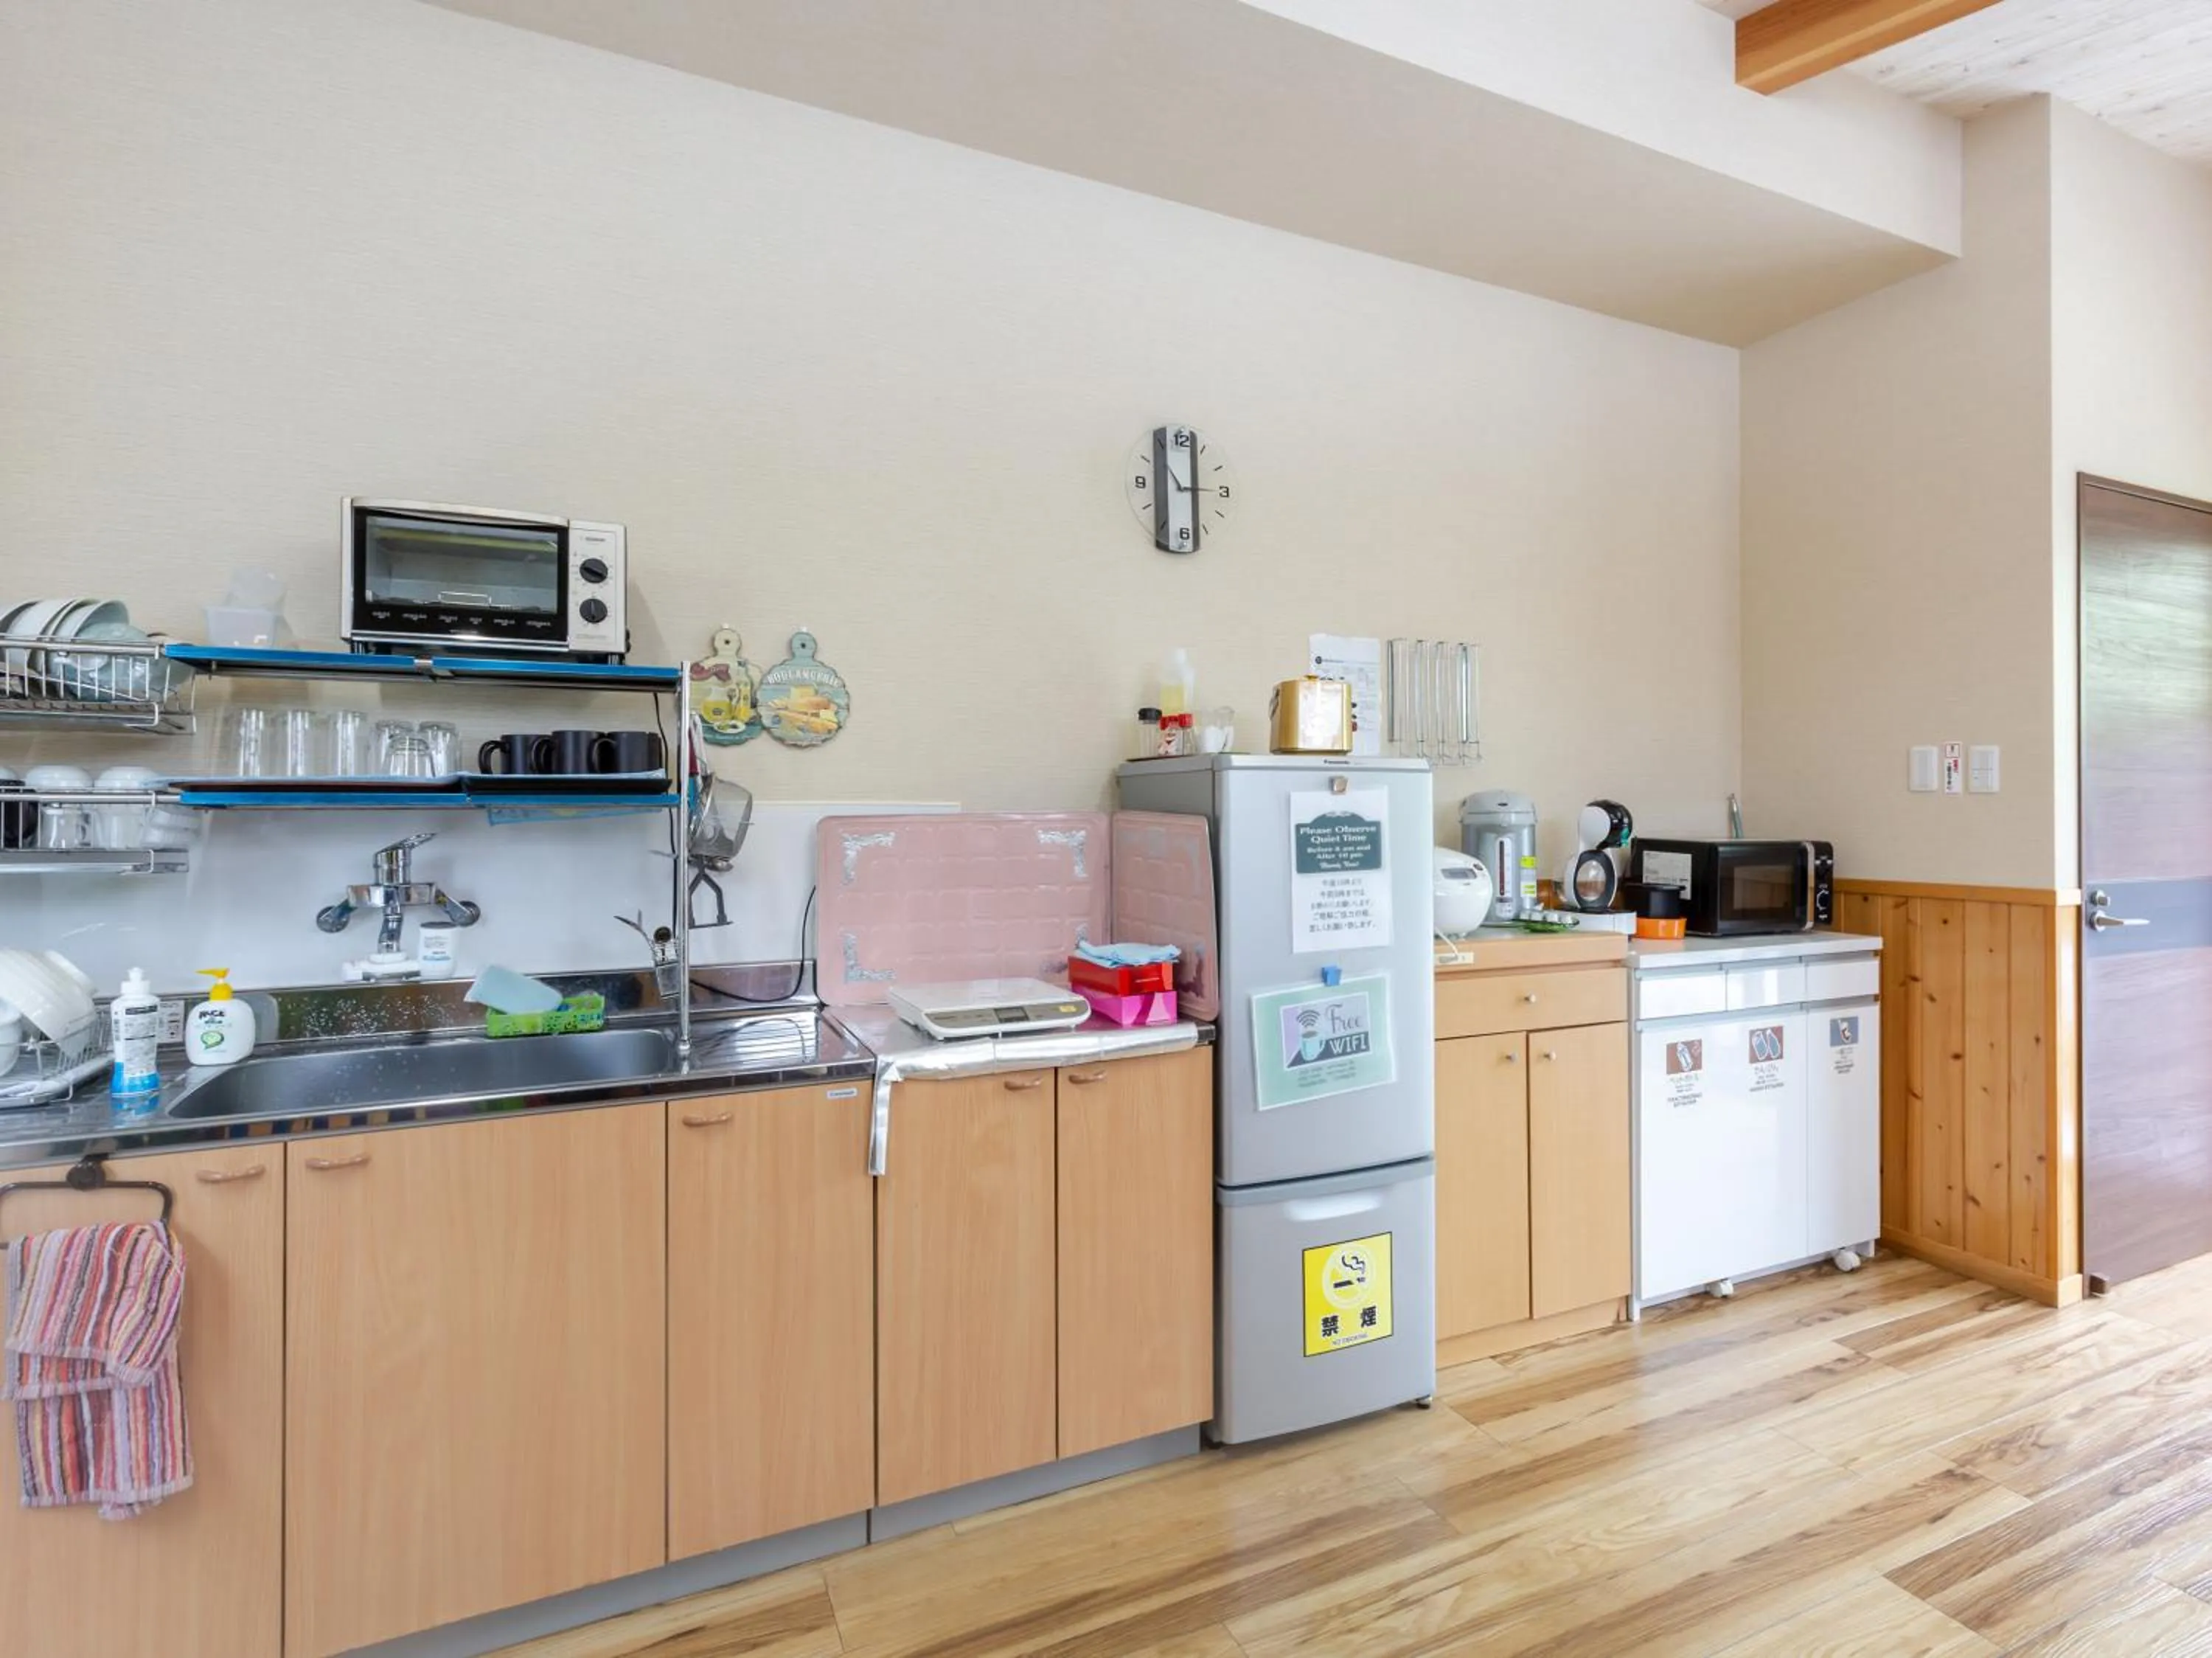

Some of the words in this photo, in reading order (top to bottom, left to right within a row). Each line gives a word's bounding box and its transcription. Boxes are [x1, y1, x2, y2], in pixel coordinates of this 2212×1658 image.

[1173, 434, 1190, 448] 12
[1135, 476, 1146, 489] 9
[1219, 486, 1230, 498] 3
[1180, 527, 1190, 541] 6
[1310, 835, 1340, 844] Quiet
[1326, 1004, 1363, 1034] Free
[1329, 1034, 1367, 1055] WIFI
